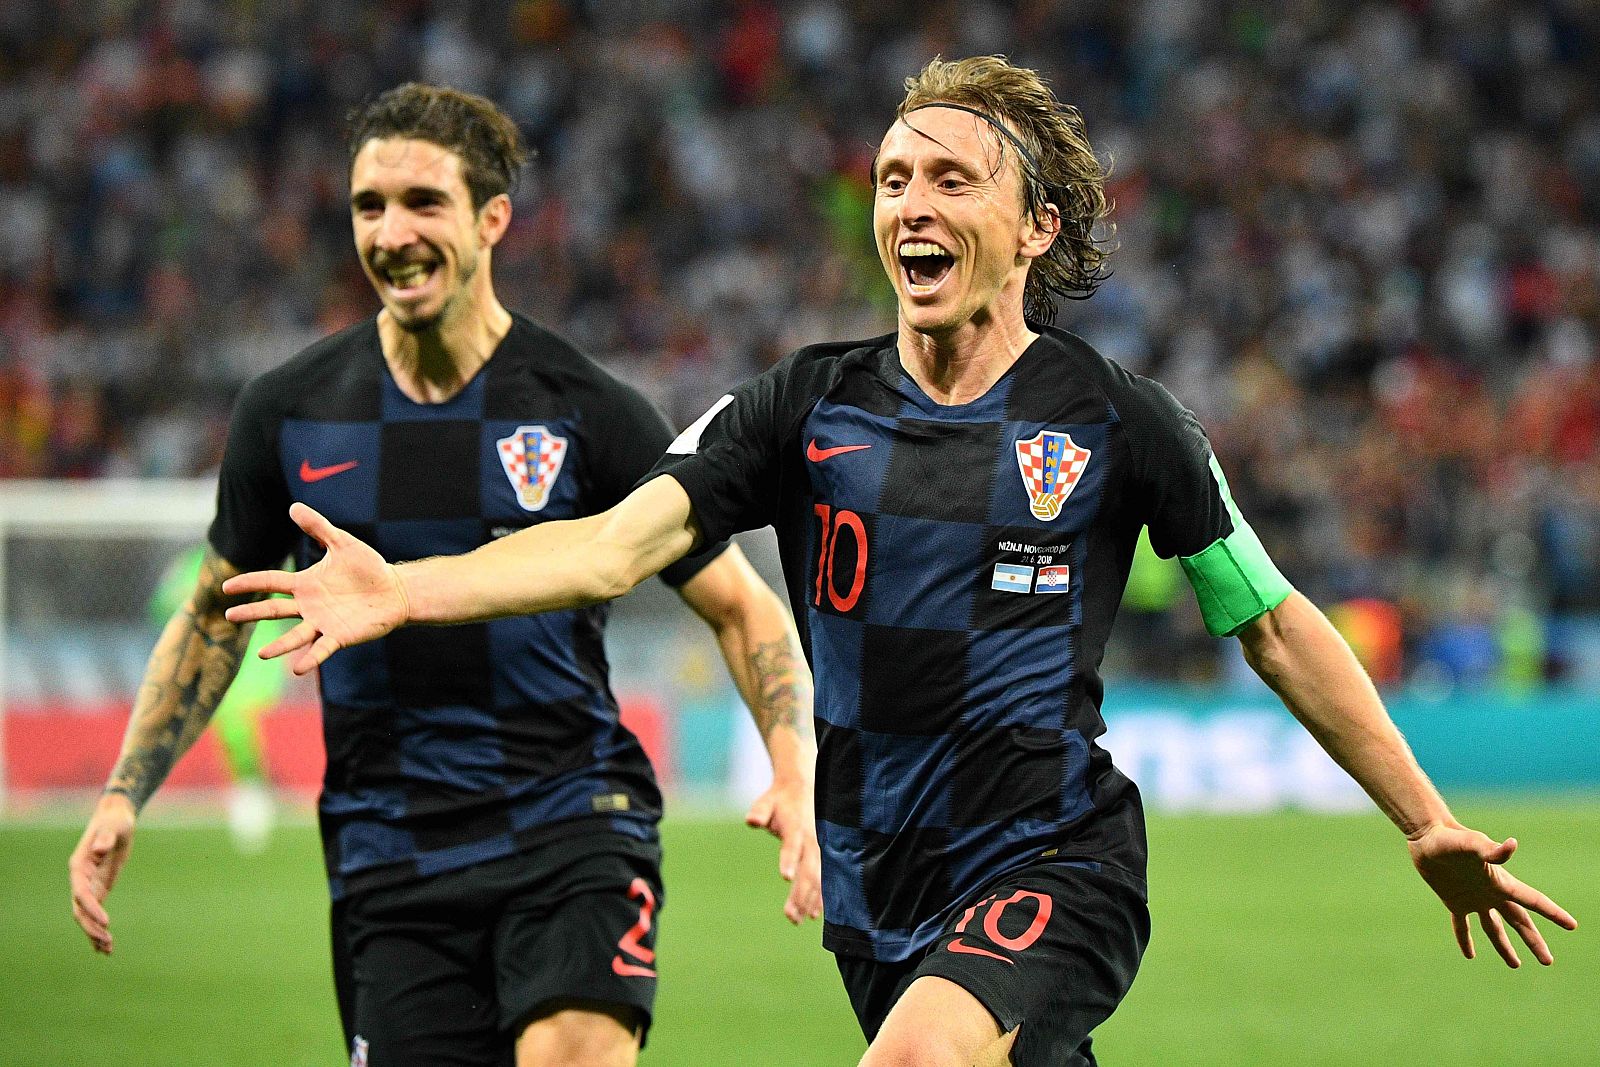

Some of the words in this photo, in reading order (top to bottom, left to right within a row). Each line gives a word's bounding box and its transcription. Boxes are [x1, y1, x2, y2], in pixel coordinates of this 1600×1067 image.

[1044, 440, 1060, 485] HNS
[813, 503, 868, 612] 10
[1036, 555, 1053, 565] 2018
[617, 877, 656, 964] 2
[954, 889, 1053, 952] 10
